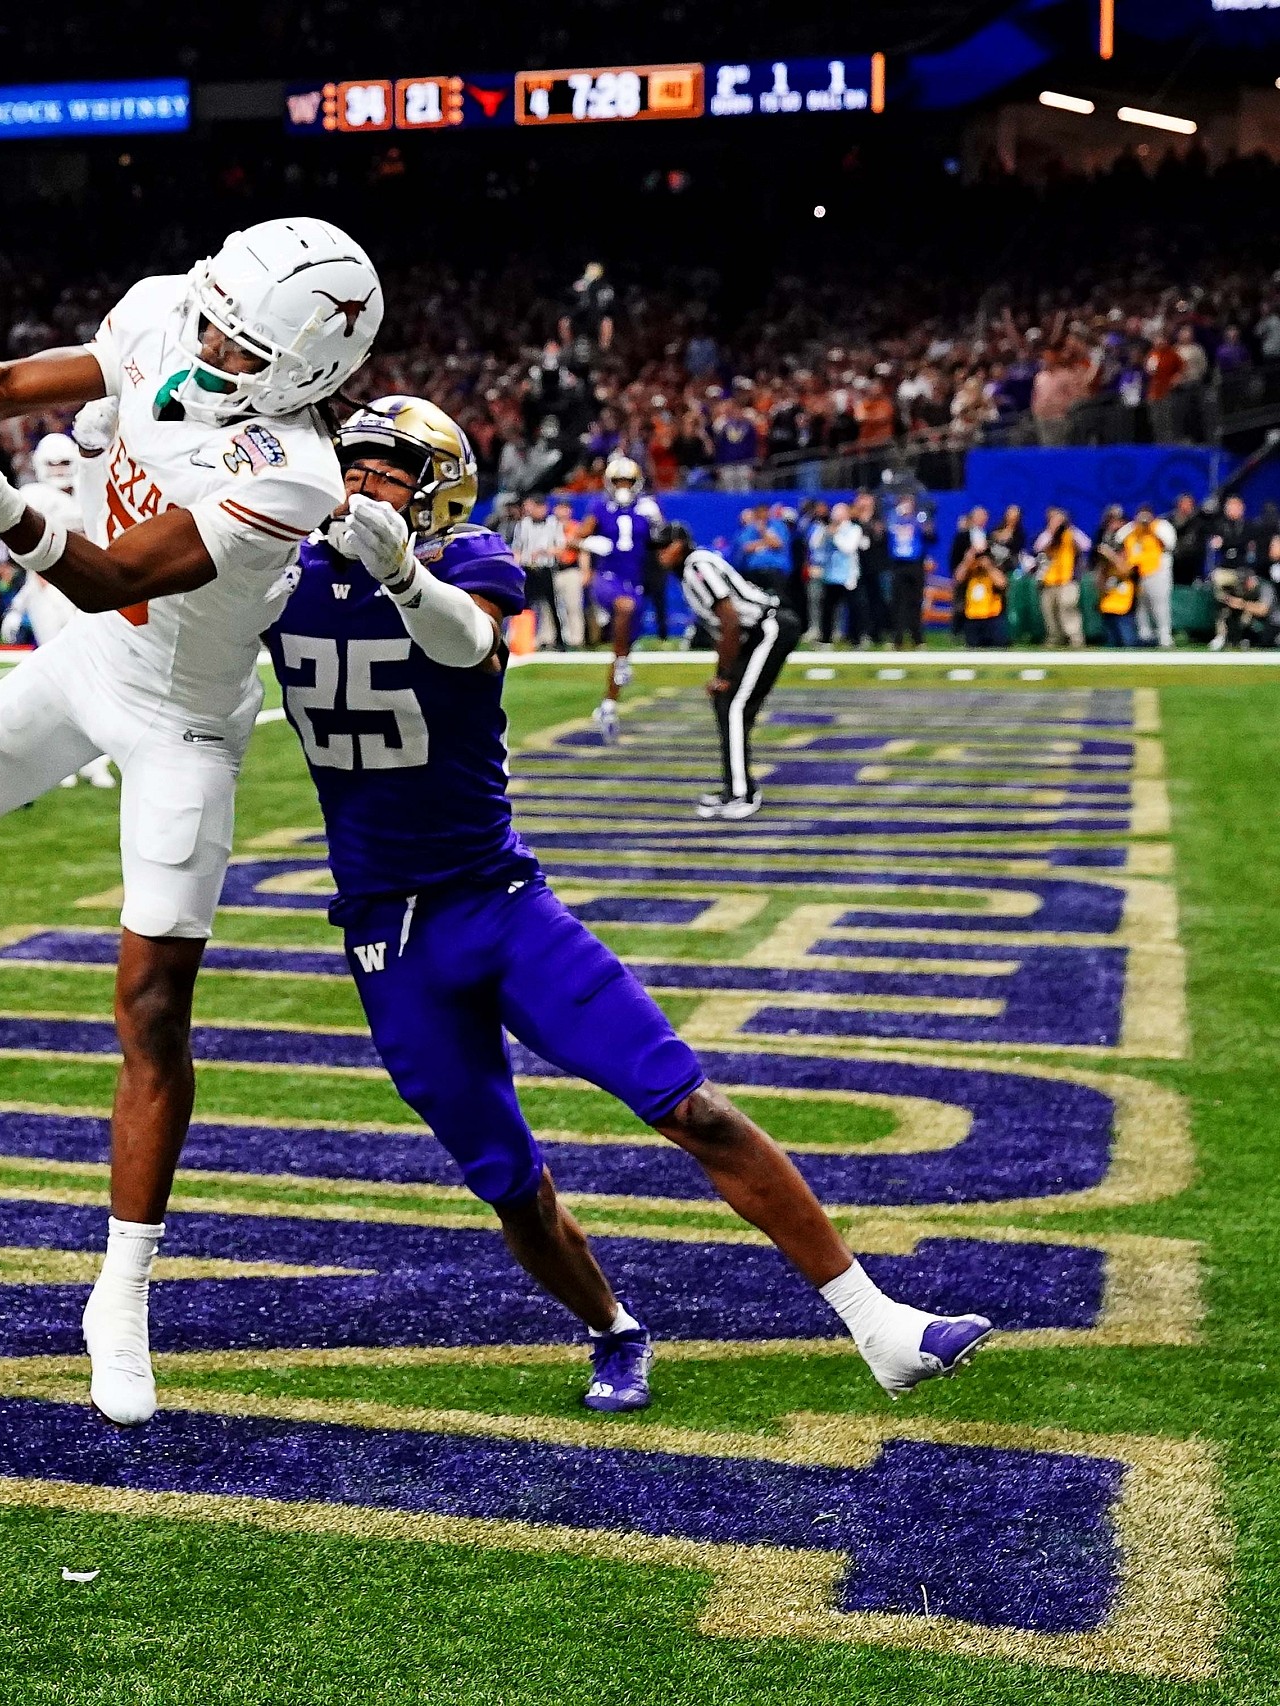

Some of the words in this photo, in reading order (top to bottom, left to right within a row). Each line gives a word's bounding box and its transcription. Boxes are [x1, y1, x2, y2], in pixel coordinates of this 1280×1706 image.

[331, 583, 352, 600] W
[280, 632, 430, 771] 25
[353, 941, 387, 973] W
